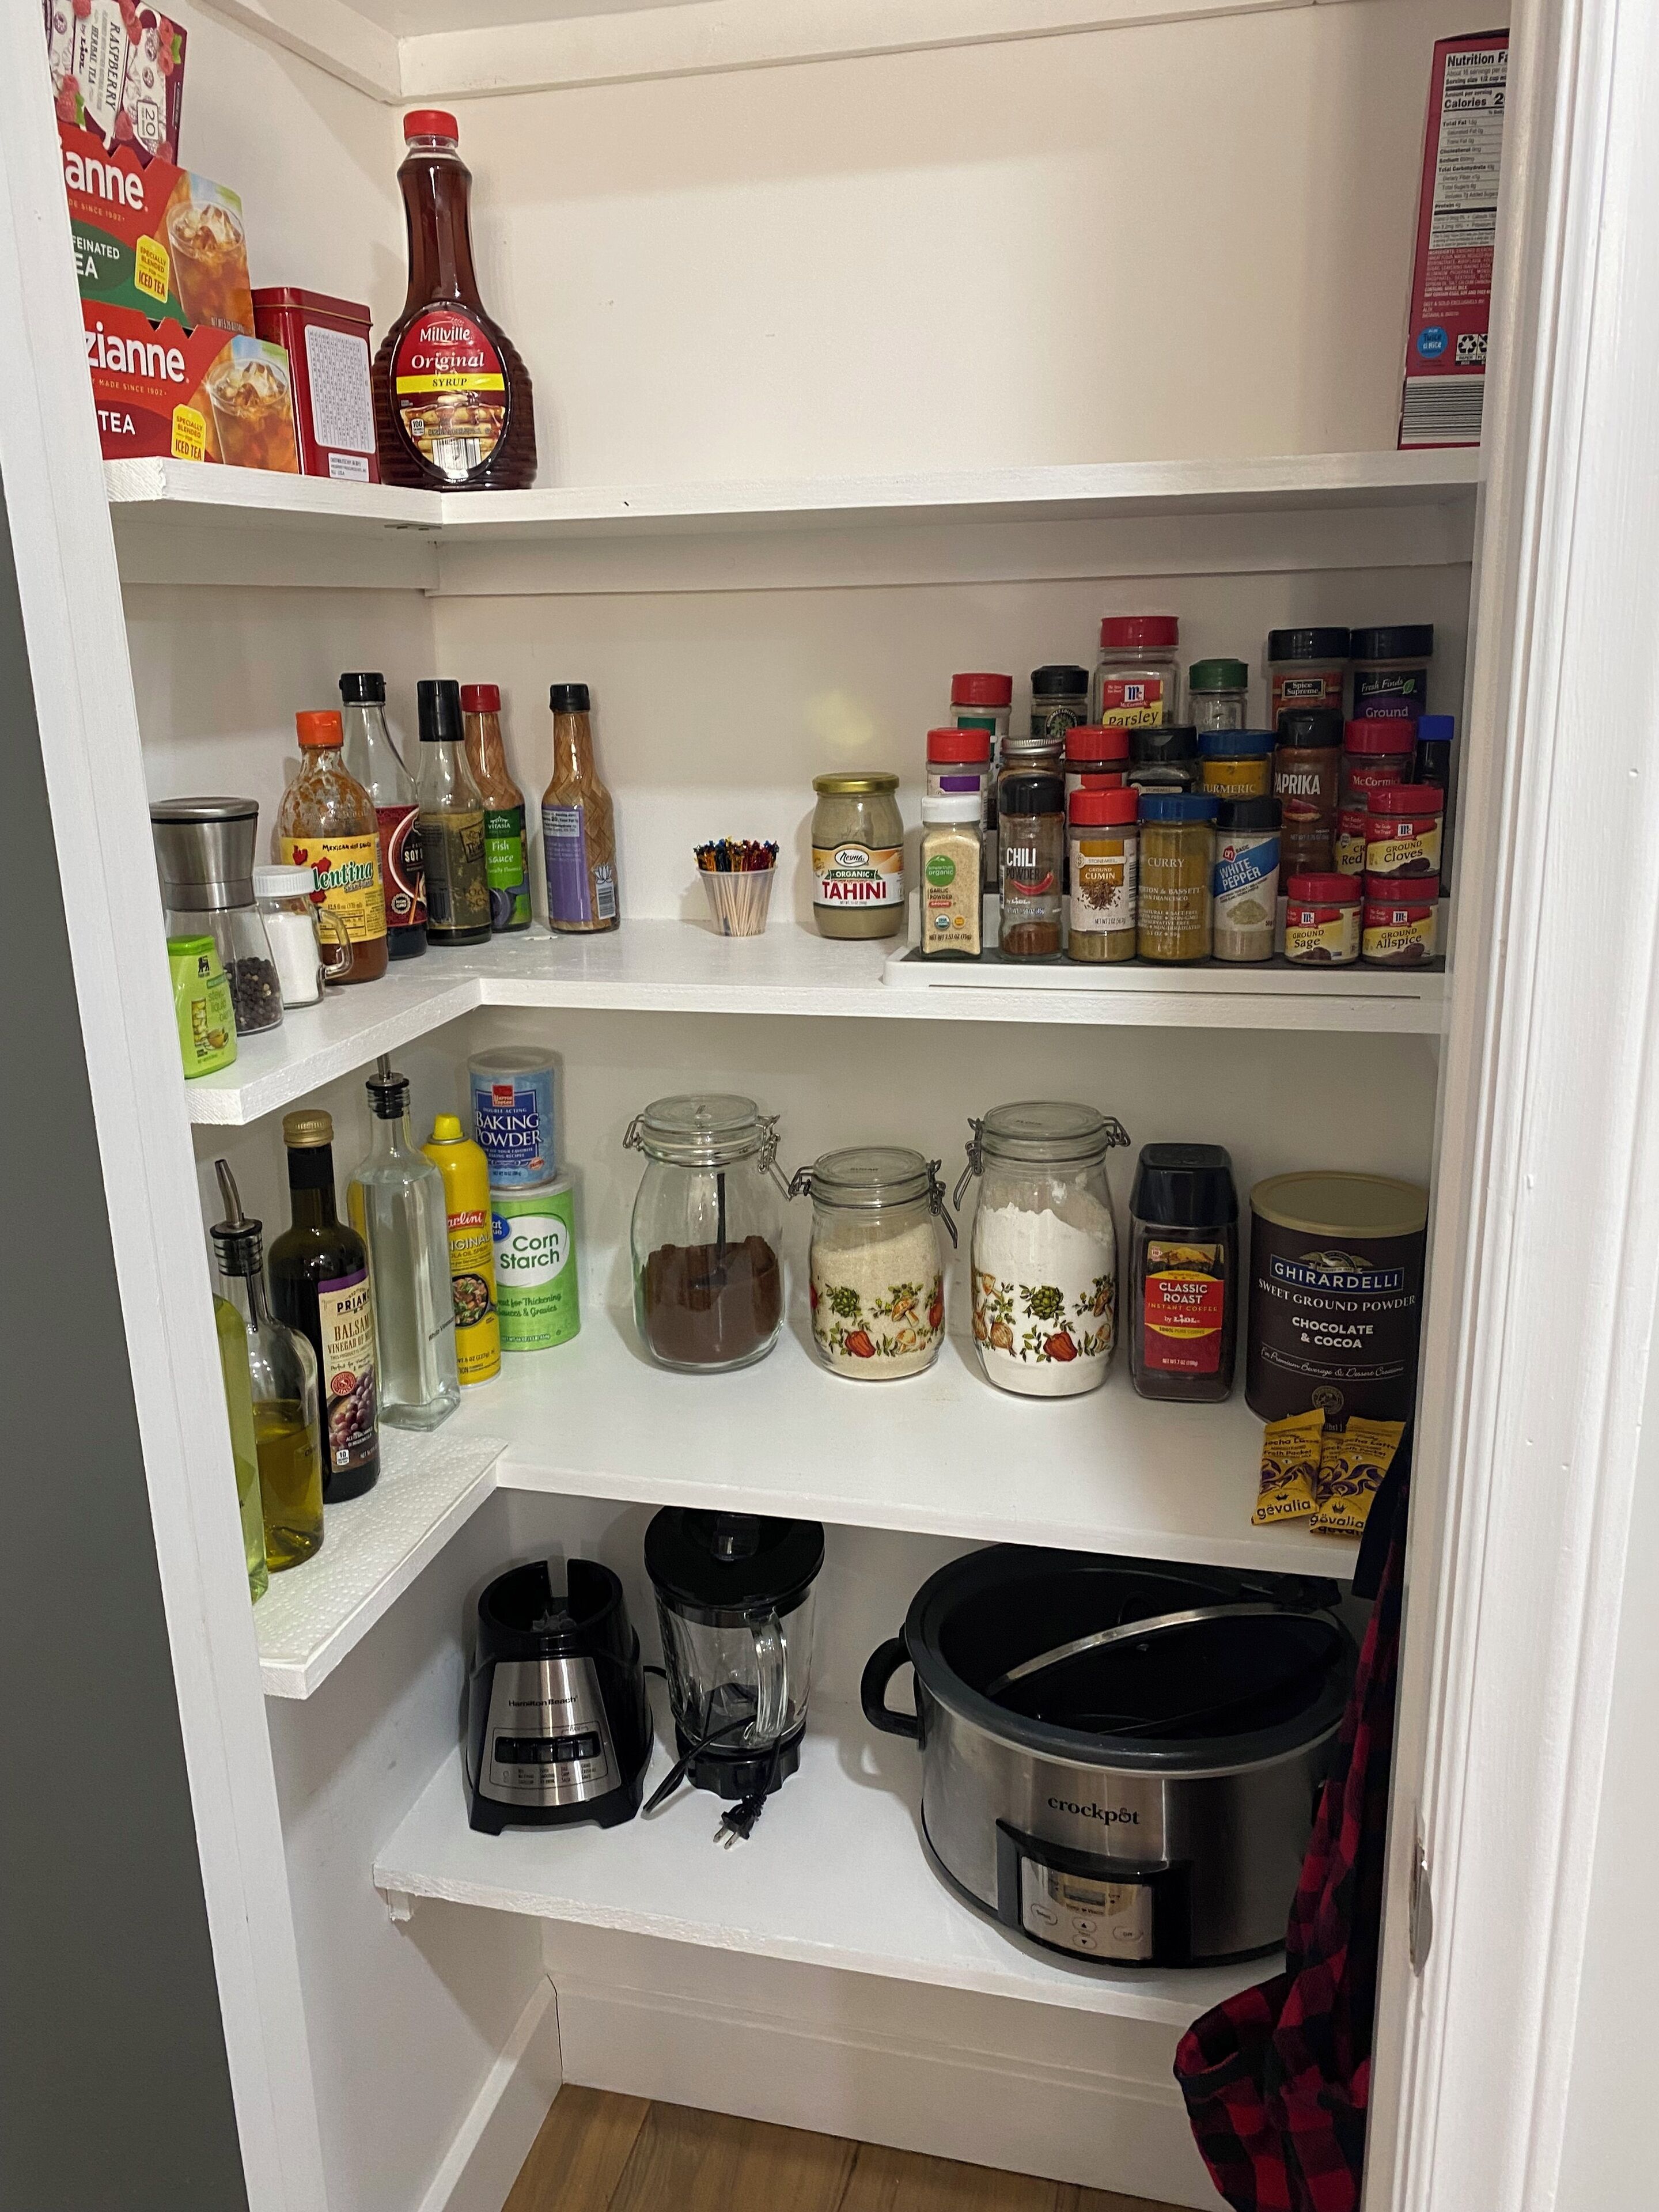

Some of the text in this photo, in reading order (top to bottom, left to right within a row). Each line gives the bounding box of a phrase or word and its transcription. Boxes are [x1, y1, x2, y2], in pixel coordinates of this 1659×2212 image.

[90, 25, 99, 63] HERBAL
[105, 21, 120, 111] RASPBERRY
[1448, 53, 1494, 67] Nutrition
[1444, 97, 1487, 108] Calories
[145, 108, 156, 136] 20
[62, 151, 144, 210] anne
[72, 235, 120, 259] FEINATED
[140, 245, 166, 265] SPECIALLY
[75, 252, 99, 279] EA
[141, 256, 165, 274] BLENDED
[139, 270, 165, 297] ICED TEA
[419, 327, 471, 342] Millville
[85, 321, 185, 382] zianne
[411, 352, 484, 370] Original
[99, 379, 119, 389] MADE
[123, 382, 144, 393] SINCE
[433, 378, 467, 387] SYRUP
[97, 410, 135, 435] TEA
[176, 415, 203, 431] SPECIALLY
[177, 423, 201, 438] BLENDED
[175, 440, 202, 461] ICED TEA
[1293, 681, 1312, 690] Spice
[1362, 677, 1403, 692] Fresh Finds
[1109, 710, 1159, 726] Parsley
[1366, 706, 1408, 718] Ground
[1275, 772, 1321, 795] PAPRIKA
[323, 844, 349, 852] MEXICAN
[493, 840, 509, 851] Fish
[1236, 844, 1250, 853] BASIC
[1386, 840, 1422, 853] GROUND
[404, 849, 419, 862] SOY
[488, 854, 514, 863] sauce
[1006, 847, 1036, 867] CHILI
[1147, 857, 1185, 868] CURRY
[1342, 854, 1362, 865] Red
[1384, 849, 1423, 863] Cloves
[312, 861, 373, 891] lentina
[928, 869, 954, 877] organic
[1006, 868, 1040, 880] POWDER
[1219, 858, 1252, 880] WHITE
[1222, 866, 1261, 891] PEPPER
[822, 881, 887, 900] TAHINI
[1293, 929, 1324, 940] GROUND
[1381, 927, 1417, 939] GROUND
[1294, 938, 1320, 950] Sage
[1376, 934, 1422, 949] Allspice
[476, 1111, 540, 1130] BAKING
[476, 1127, 542, 1147] POWDER
[448, 1211, 483, 1228] arlini
[451, 1232, 491, 1251] IGINAL
[513, 1233, 559, 1252] Corn
[500, 1249, 560, 1270] Starch
[1274, 1262, 1398, 1289] GHIRARDELLI
[1159, 1282, 1208, 1294] CLASSIC
[1259, 1278, 1416, 1312] SWEET GROUND POWDER
[511, 1293, 562, 1308] for Thickening
[1147, 1302, 1183, 1311] INSTANT
[1164, 1293, 1203, 1304] ROAST
[523, 1308, 529, 1317] &
[530, 1304, 558, 1317] Gravies
[1291, 1316, 1374, 1335] CHOCOLATE
[328, 1338, 357, 1354] VINEGAR
[1300, 1332, 1363, 1349] & COCOA
[1270, 1351, 1301, 1369] Premium
[1300, 1362, 1333, 1377] Beverage
[1345, 1368, 1374, 1377] Dessert
[509, 1696, 577, 1707] Hamilton Beach
